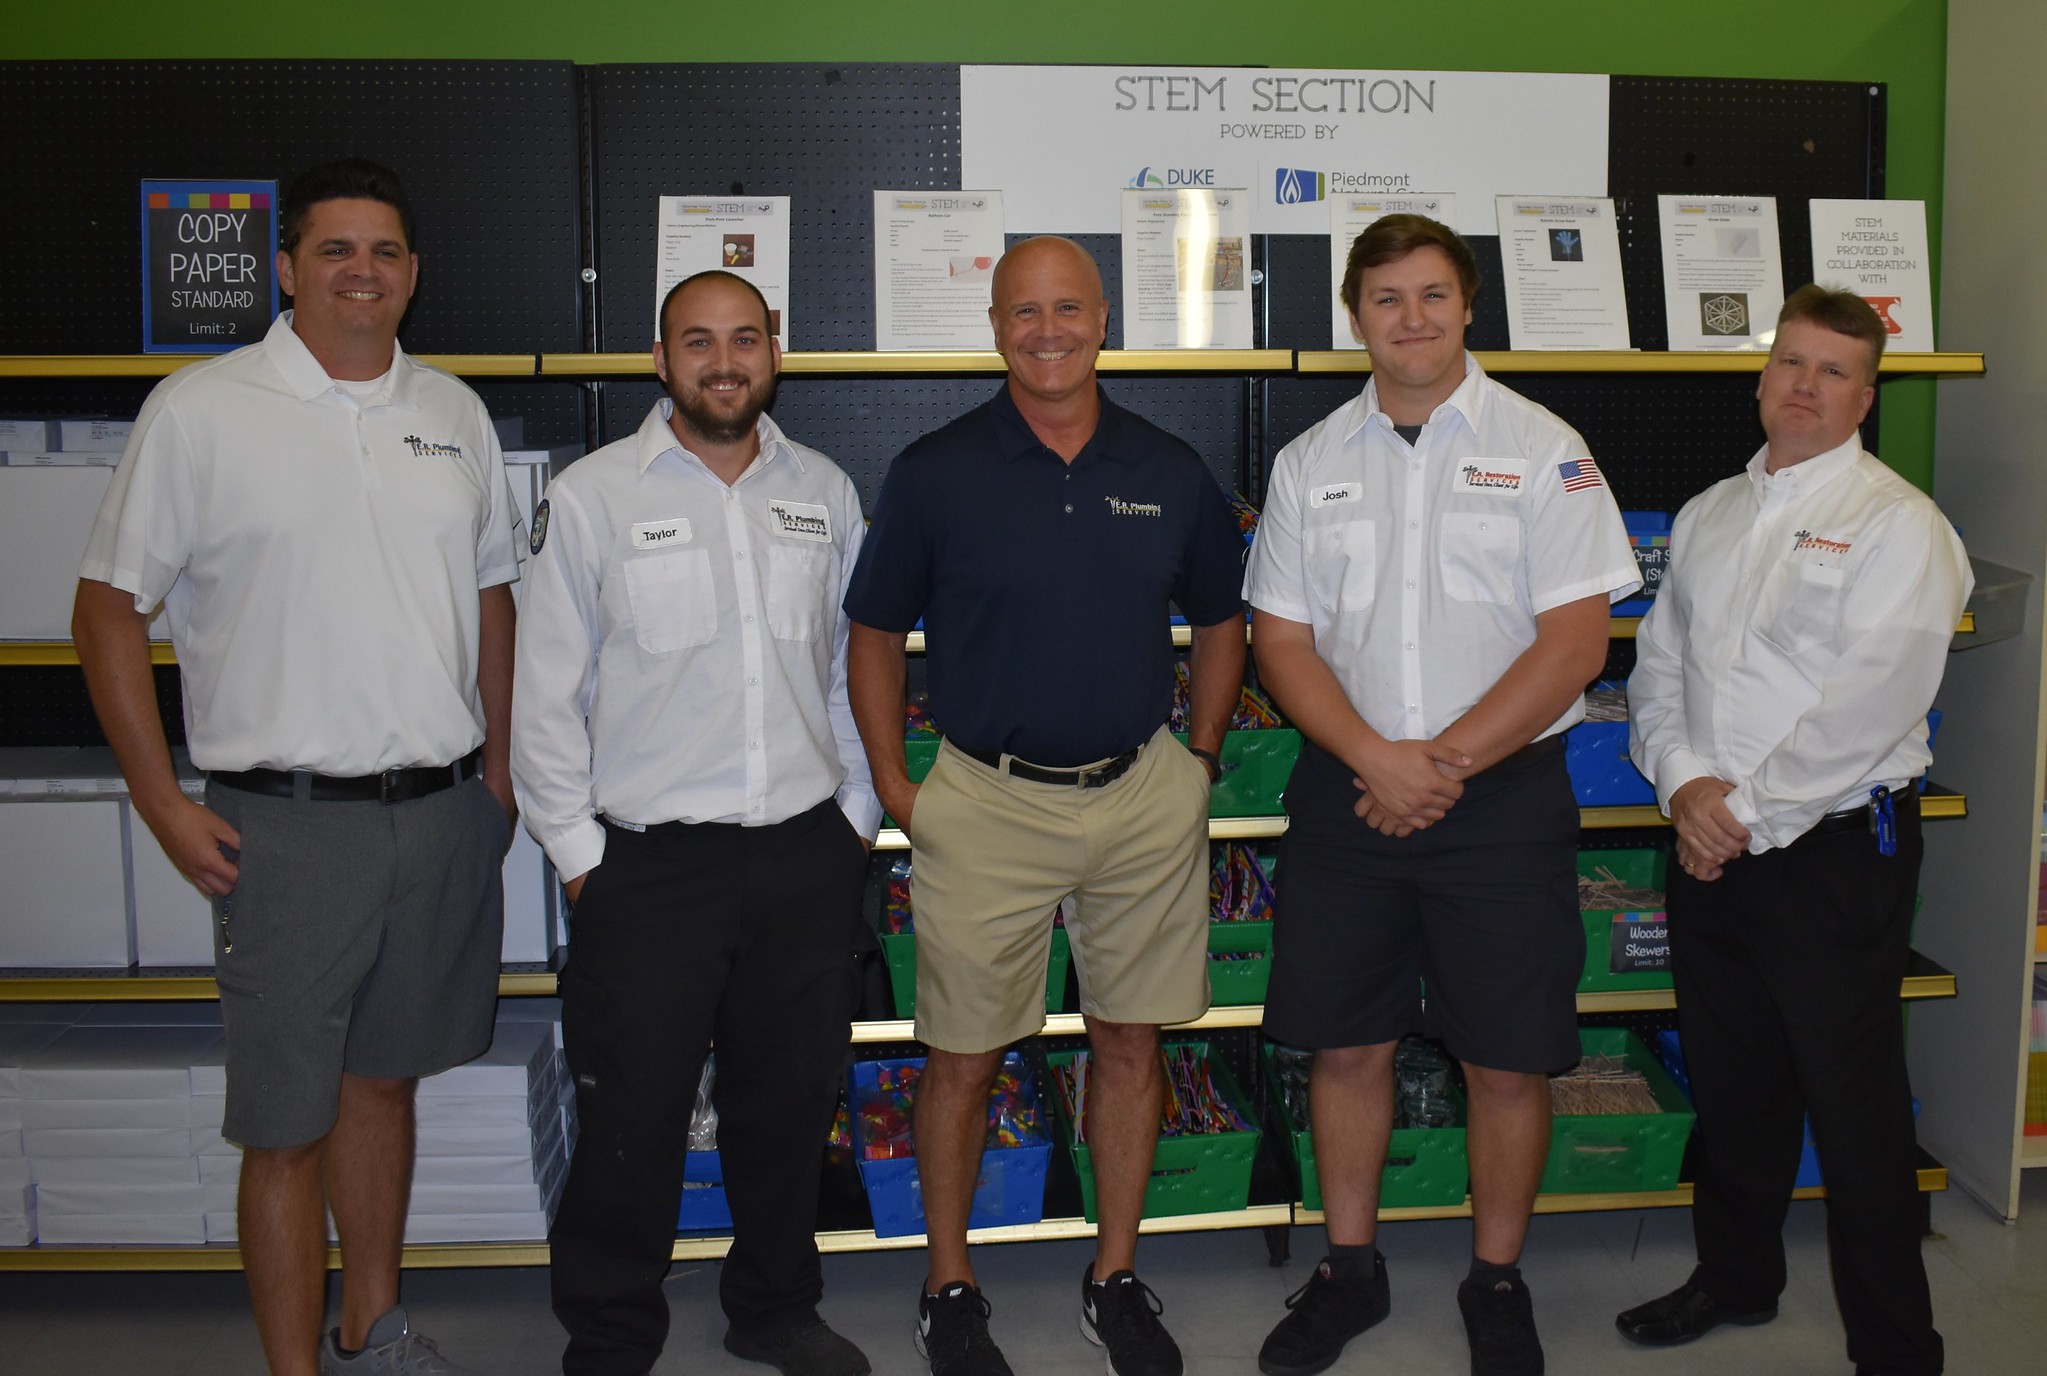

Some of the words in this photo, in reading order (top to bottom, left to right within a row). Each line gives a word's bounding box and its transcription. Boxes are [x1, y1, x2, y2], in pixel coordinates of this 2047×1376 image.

[1115, 76, 1227, 111] STEM
[1252, 77, 1436, 113] SECTION
[1220, 124, 1306, 139] POWERED
[1314, 125, 1339, 139] BY
[1168, 169, 1214, 185] DUKE
[1331, 172, 1410, 186] Piedmont
[717, 203, 745, 213] STEM
[931, 199, 959, 209] STEM
[1386, 201, 1412, 211] STEM
[1711, 203, 1736, 213] STEM
[1549, 205, 1575, 215] STEM
[178, 213, 247, 243] COPY
[1855, 217, 1883, 228] STEM
[1841, 232, 1899, 242] MATERIALS
[1837, 245, 1888, 256] PROVIDED
[1893, 246, 1905, 256] IN
[170, 252, 257, 283] PAPER
[1826, 259, 1917, 270] COLLABORATION
[1858, 273, 1888, 284] WITH
[171, 290, 254, 308] STANDARD
[189, 322, 225, 334] Limit:
[228, 322, 237, 334] 2
[1485, 471, 1521, 480] Restoration
[1322, 490, 1348, 501] Josh
[1115, 508, 1161, 517] SERVICES
[1130, 502, 1161, 512] Plumbing
[643, 529, 677, 541] Taylor
[1633, 549, 1662, 562] Craft
